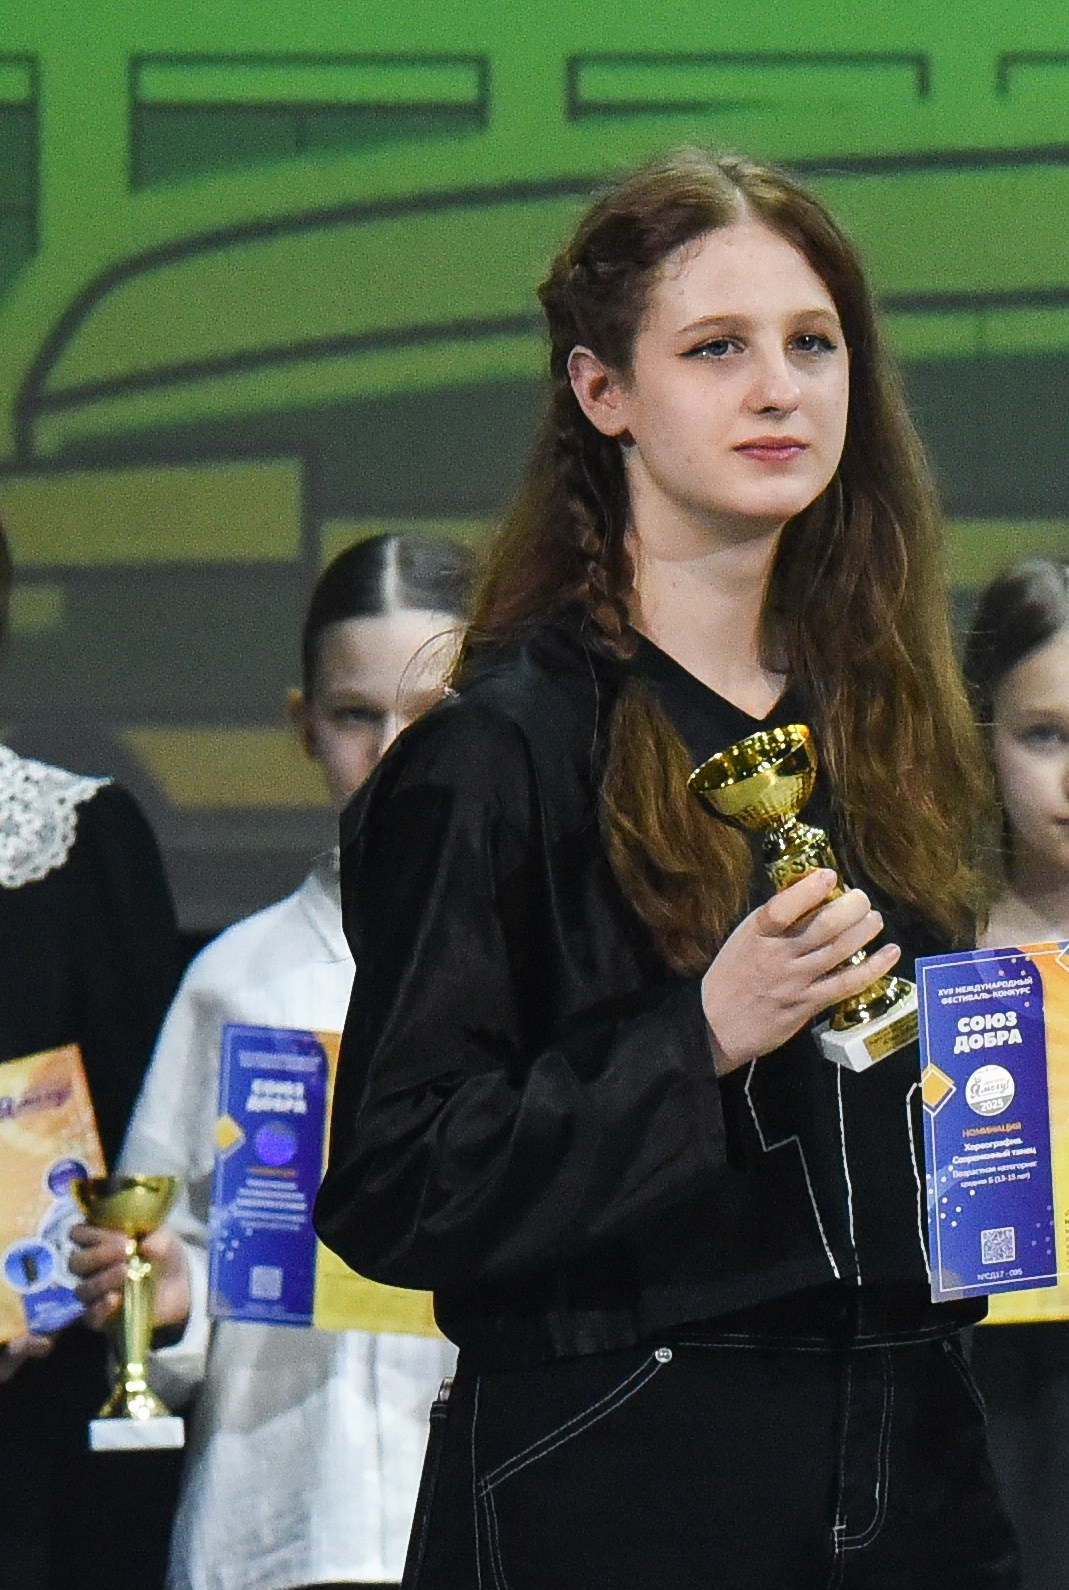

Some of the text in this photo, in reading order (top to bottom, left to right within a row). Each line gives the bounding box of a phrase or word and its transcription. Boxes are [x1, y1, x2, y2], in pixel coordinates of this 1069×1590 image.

[957, 1011, 1017, 1033] СОЮЗ
[953, 1028, 1023, 1055] ДОБРА
[980, 1099, 1004, 1112] 2025
